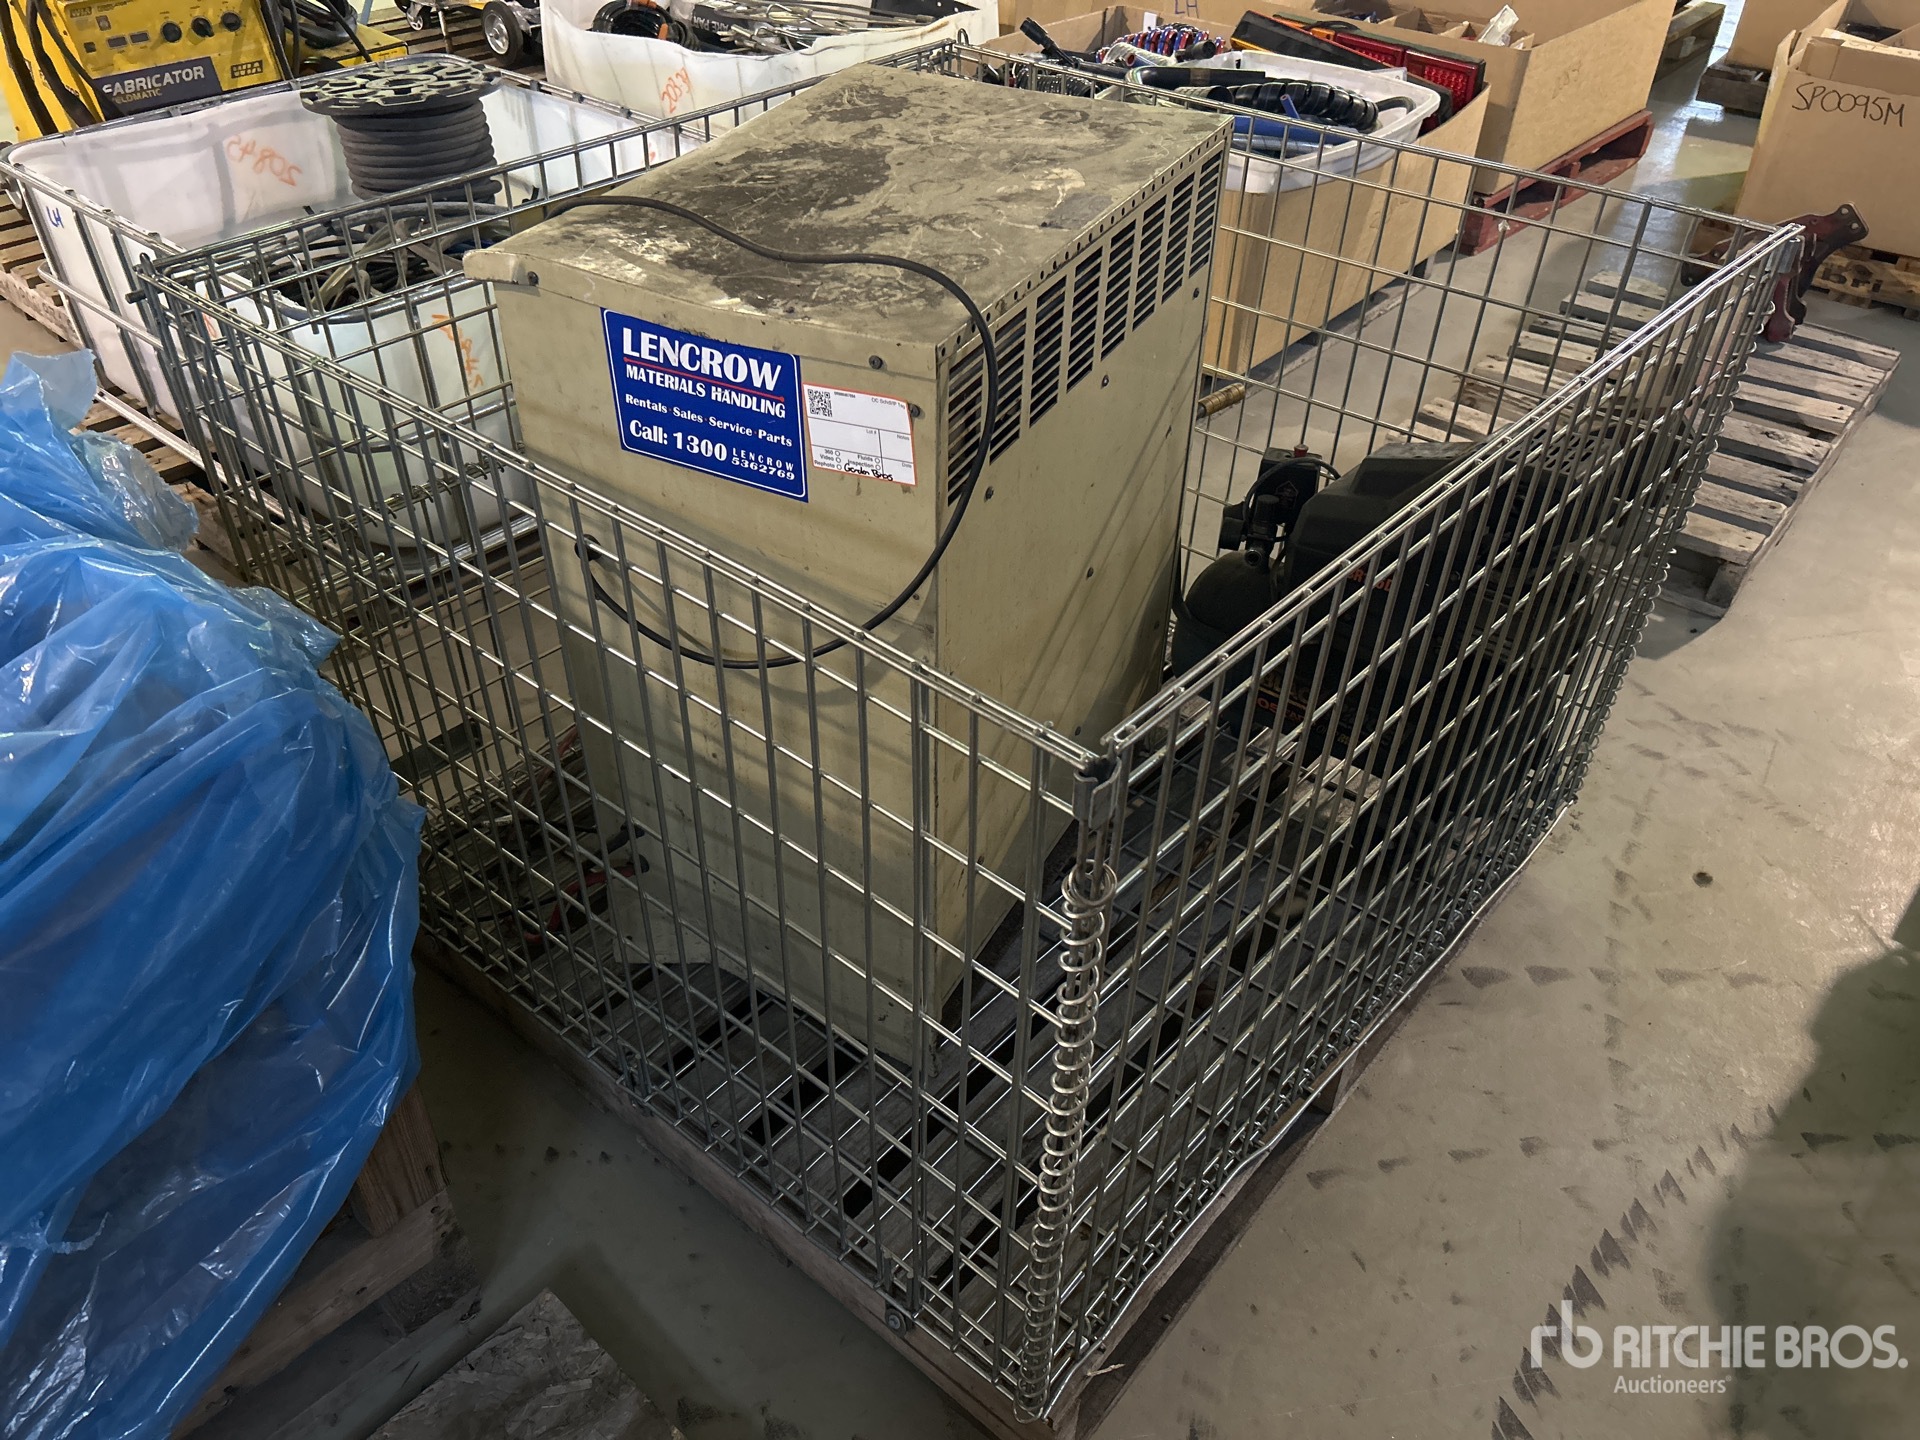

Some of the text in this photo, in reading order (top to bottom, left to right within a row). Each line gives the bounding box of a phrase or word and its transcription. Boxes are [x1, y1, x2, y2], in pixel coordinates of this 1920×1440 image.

[111, 88, 163, 105] ELDMATIC
[622, 327, 782, 392] LENCROW
[626, 364, 786, 419] MATERIALS HANDLING
[625, 393, 793, 448] Rentals Sales Service Parts
[629, 419, 728, 462] Call: 1300
[731, 447, 795, 471] LENCROW
[731, 457, 796, 481] 5362769
[814, 459, 836, 469] Rephoto
[820, 453, 835, 462] Video
[847, 459, 874, 469] Inspection
[857, 454, 874, 462] Fluids
